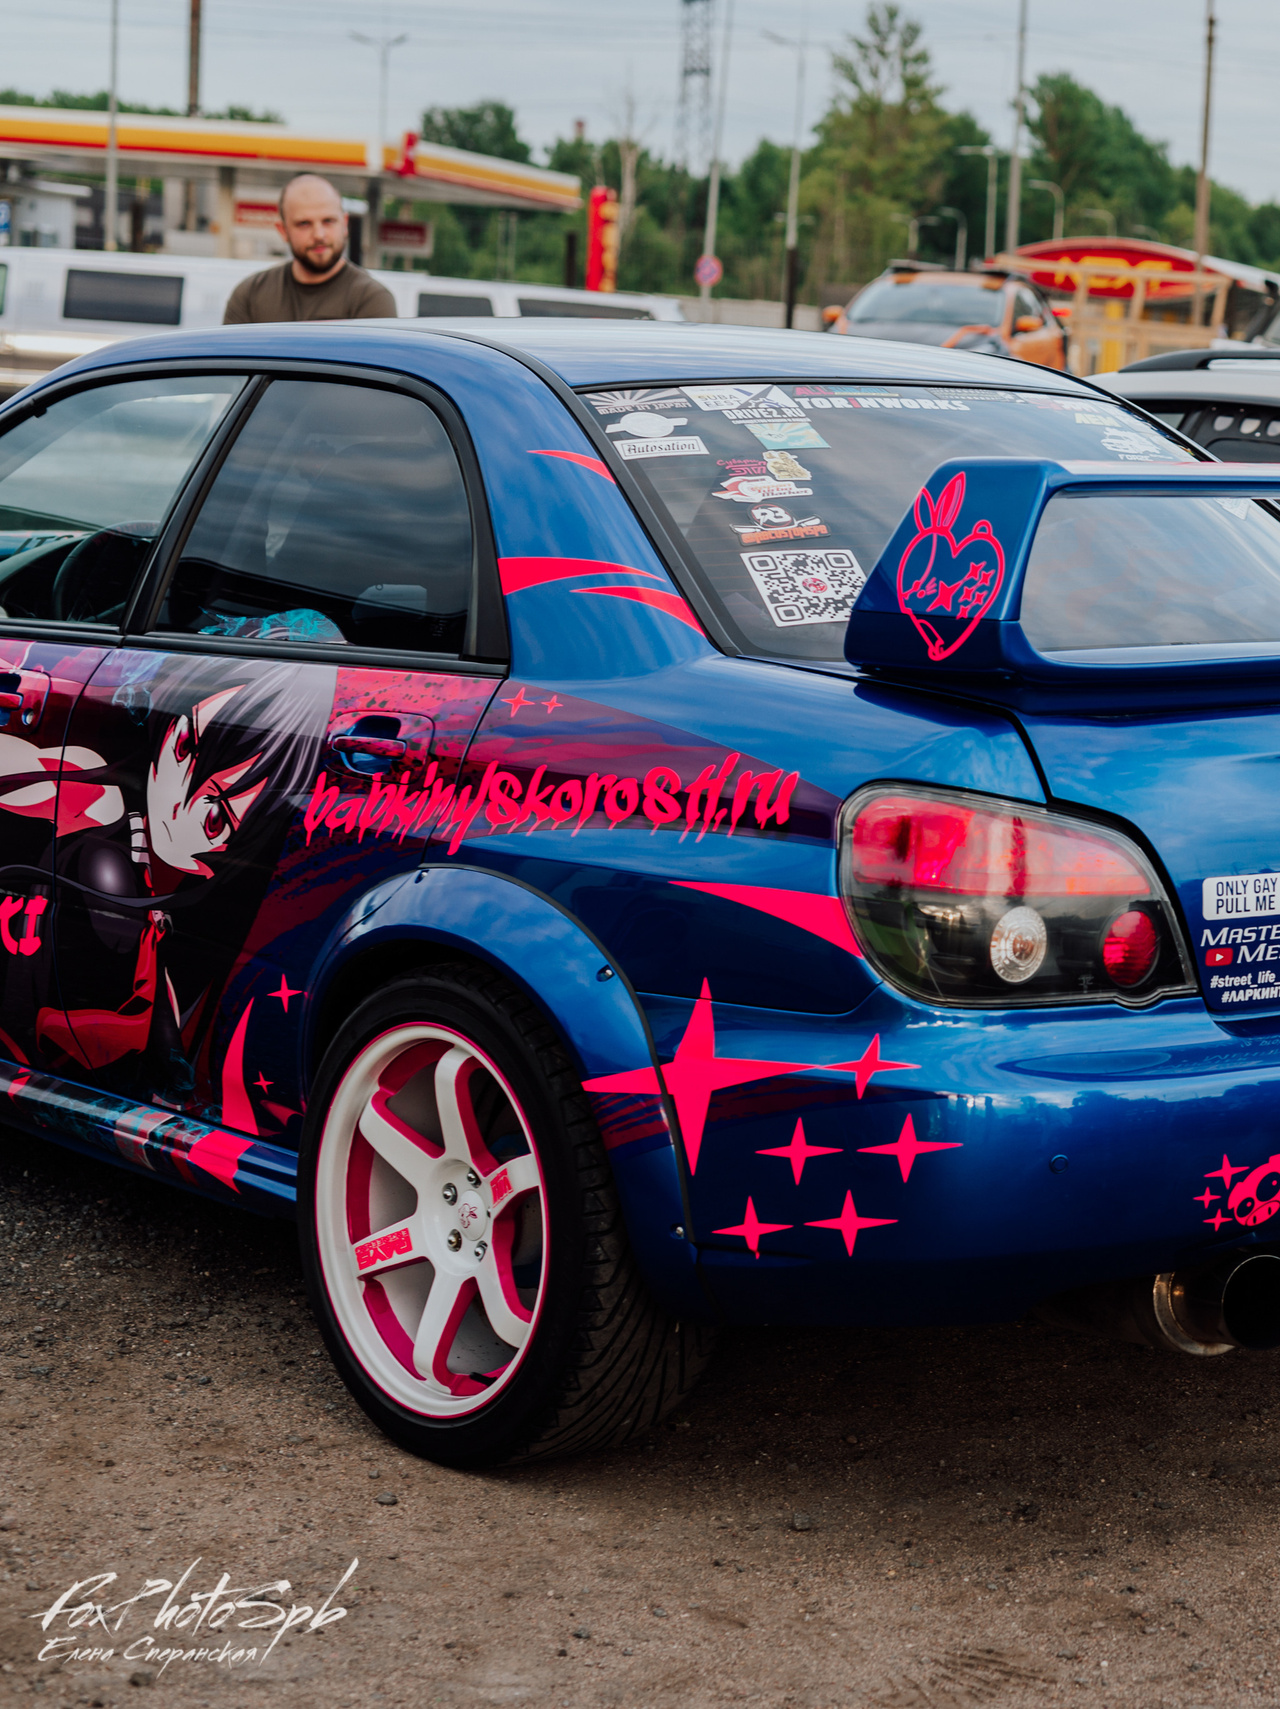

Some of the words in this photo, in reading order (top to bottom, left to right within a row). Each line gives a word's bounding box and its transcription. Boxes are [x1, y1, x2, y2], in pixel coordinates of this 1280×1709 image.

[595, 404, 634, 415] MADE
[652, 401, 692, 410] JAPAN
[722, 408, 806, 420] DRIVE2.RU
[1216, 880, 1249, 897] ONLY
[1253, 877, 1278, 893] GAY
[1216, 897, 1251, 915] PULL
[1255, 894, 1276, 912] ME
